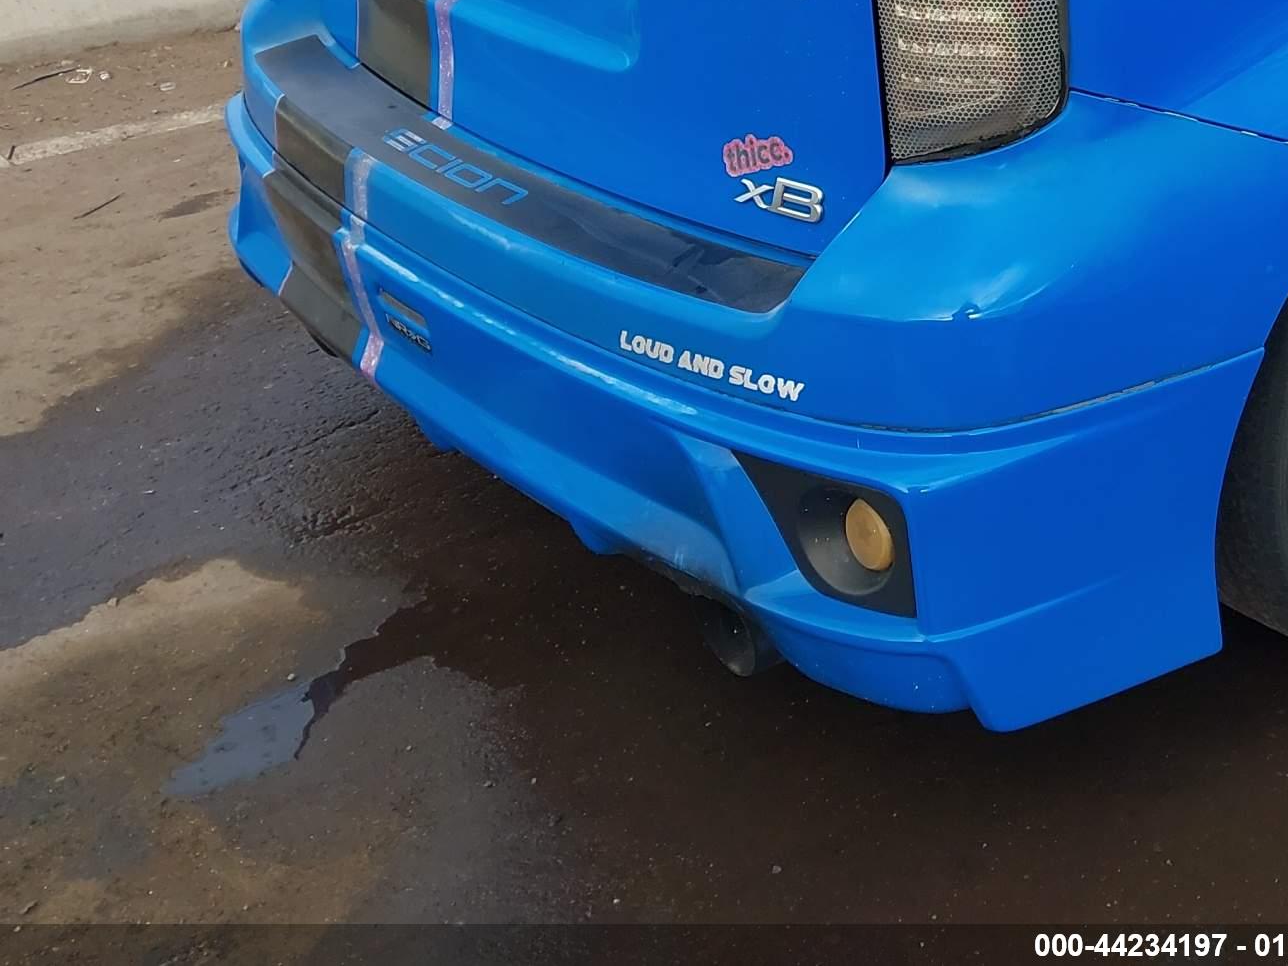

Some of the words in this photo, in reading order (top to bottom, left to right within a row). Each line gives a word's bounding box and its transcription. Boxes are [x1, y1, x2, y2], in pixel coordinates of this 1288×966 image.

[733, 176, 824, 223] xB
[619, 330, 674, 364] LOUD
[677, 350, 725, 380] AND
[728, 365, 805, 402] SLOW
